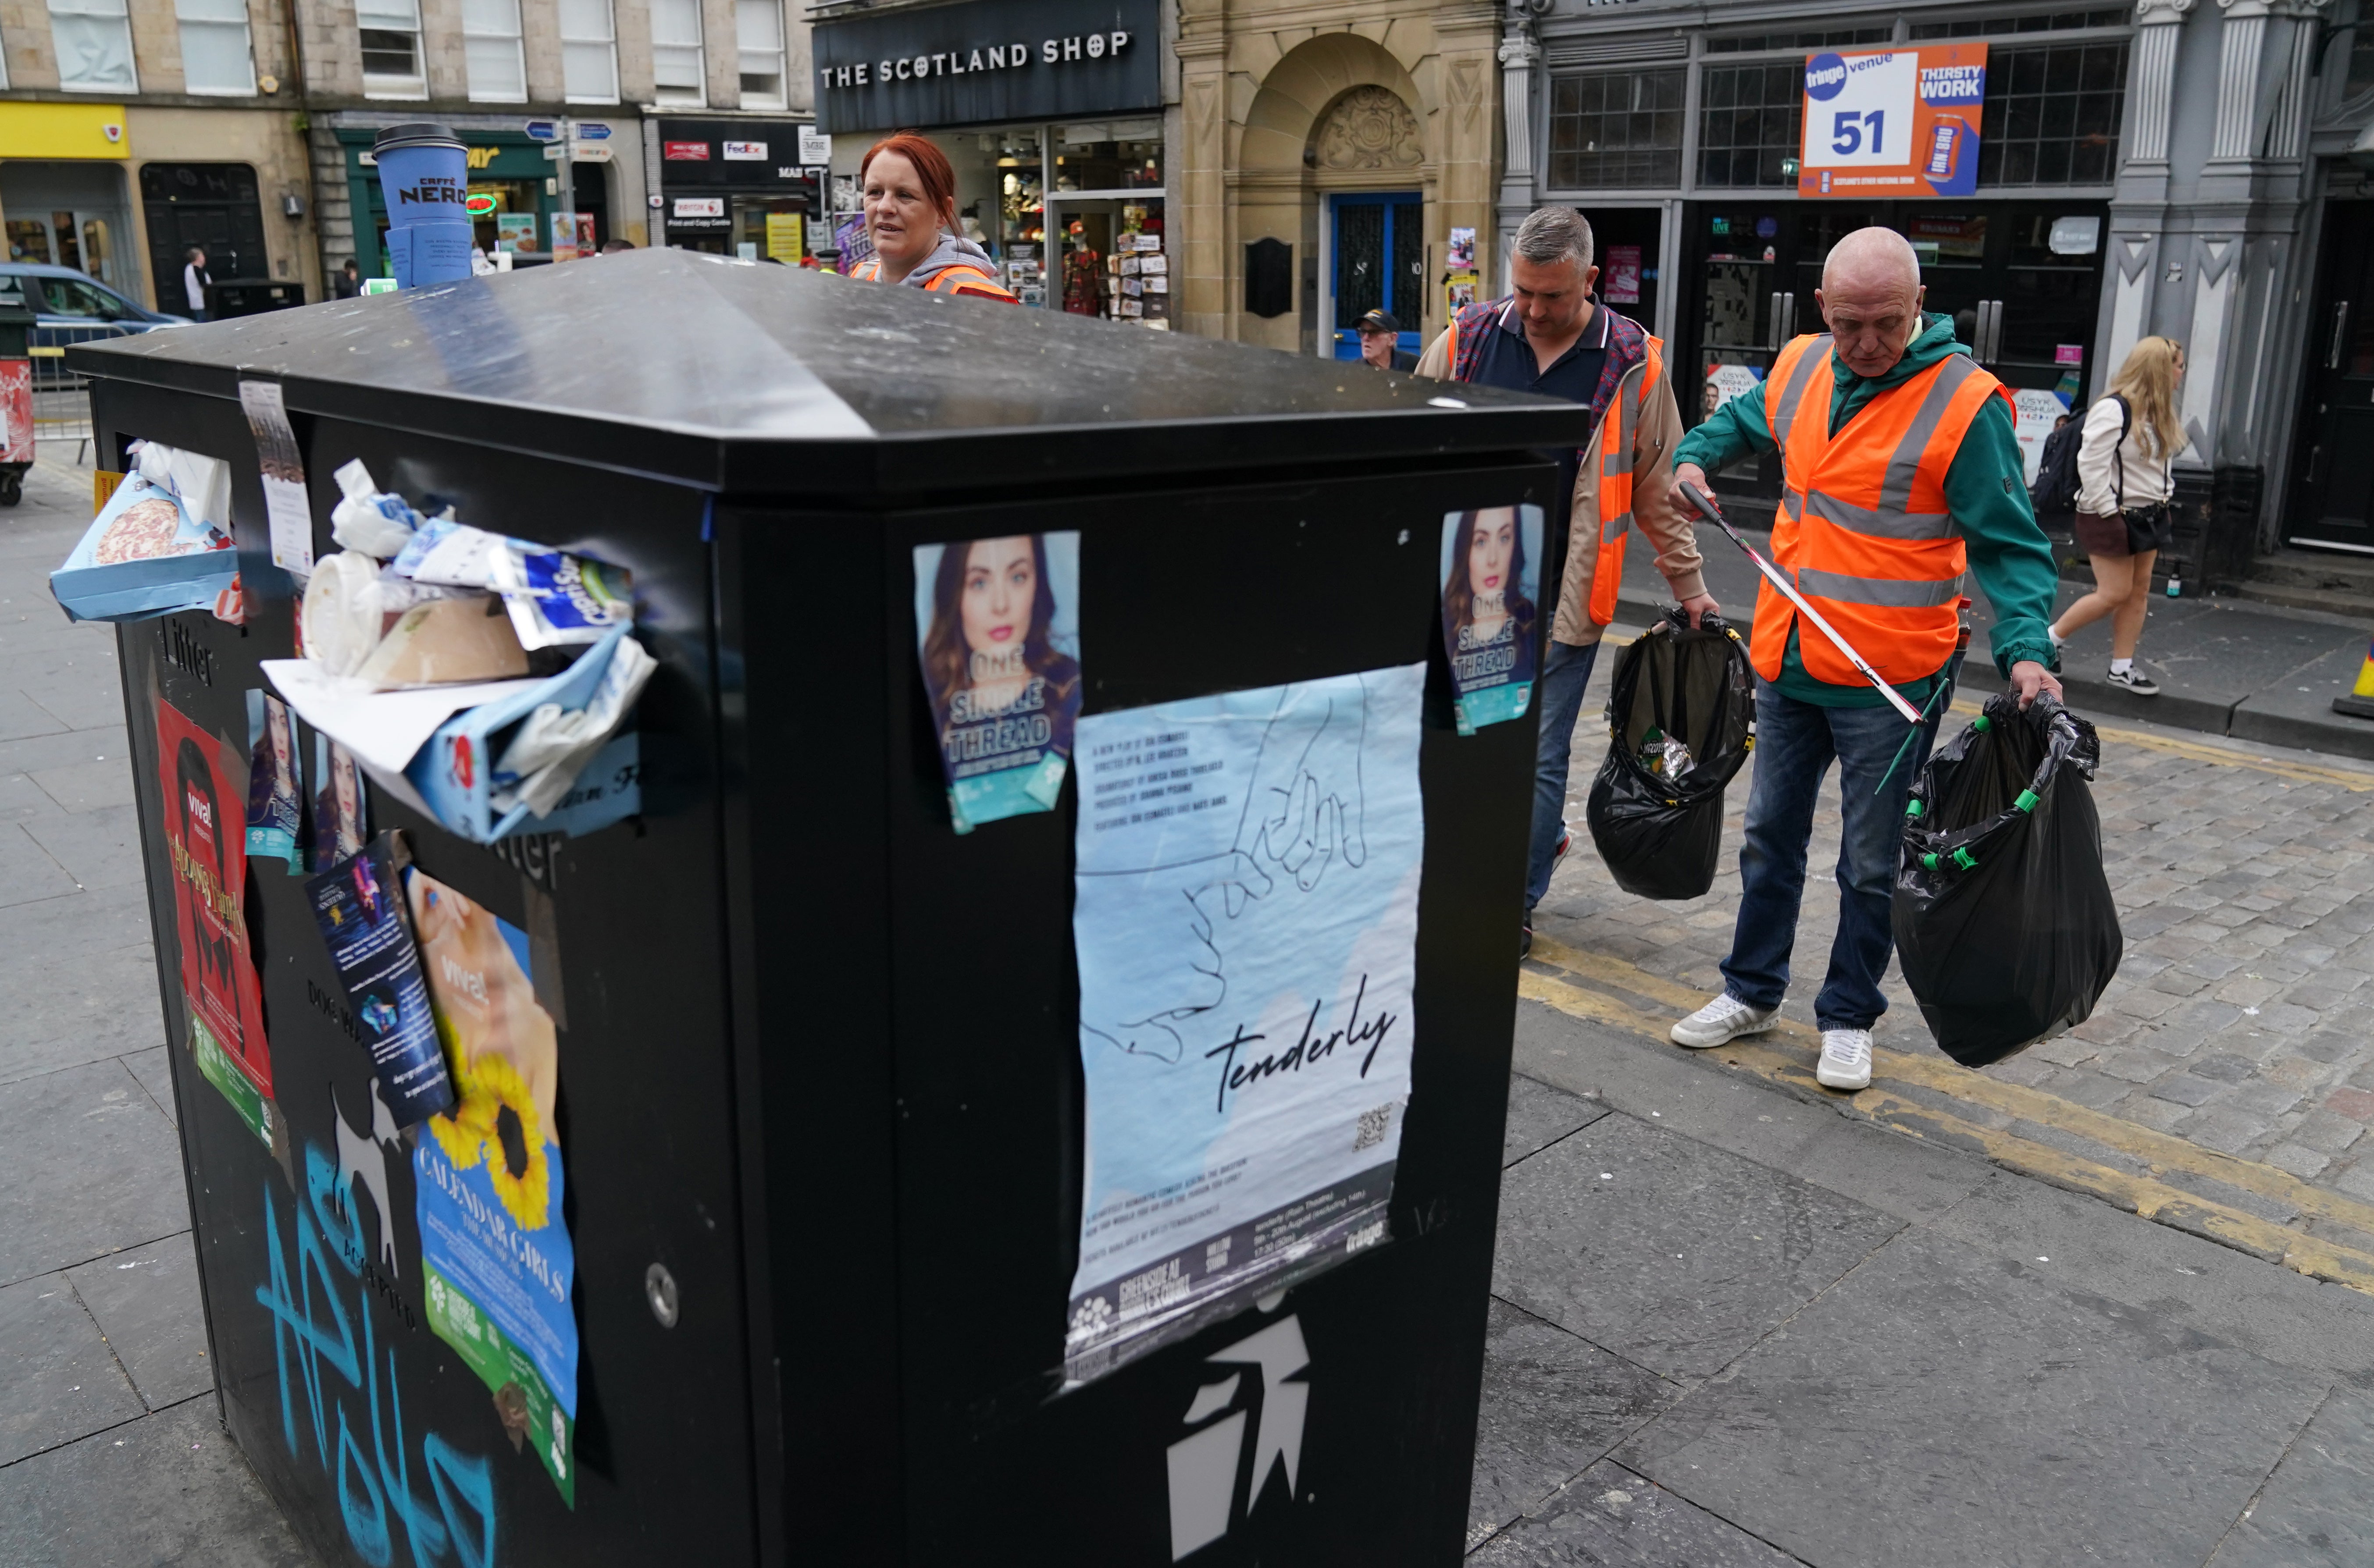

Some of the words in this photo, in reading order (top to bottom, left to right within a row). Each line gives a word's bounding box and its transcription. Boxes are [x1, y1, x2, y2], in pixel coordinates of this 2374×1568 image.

[820, 63, 869, 89] THE
[880, 43, 1028, 82] SCOTLAND
[1043, 31, 1132, 63] SHOP
[1806, 65, 1844, 88] fringe
[1849, 53, 1893, 73] venue
[1920, 66, 1982, 81] THIRSTY
[1919, 78, 1979, 98] WORK
[1832, 110, 1885, 155] 51
[727, 144, 760, 154] FedEx
[399, 187, 466, 205] NERO
[1713, 223, 1730, 233] LIVE
[2021, 397, 2050, 405] USYK
[1472, 589, 1505, 619] ONE
[970, 643, 1025, 681] ONE
[1453, 645, 1517, 680] THREAD
[944, 714, 1052, 763] THREAD
[419, 1146, 509, 1248] CALENDAR
[510, 1230, 565, 1303] GIRLS
